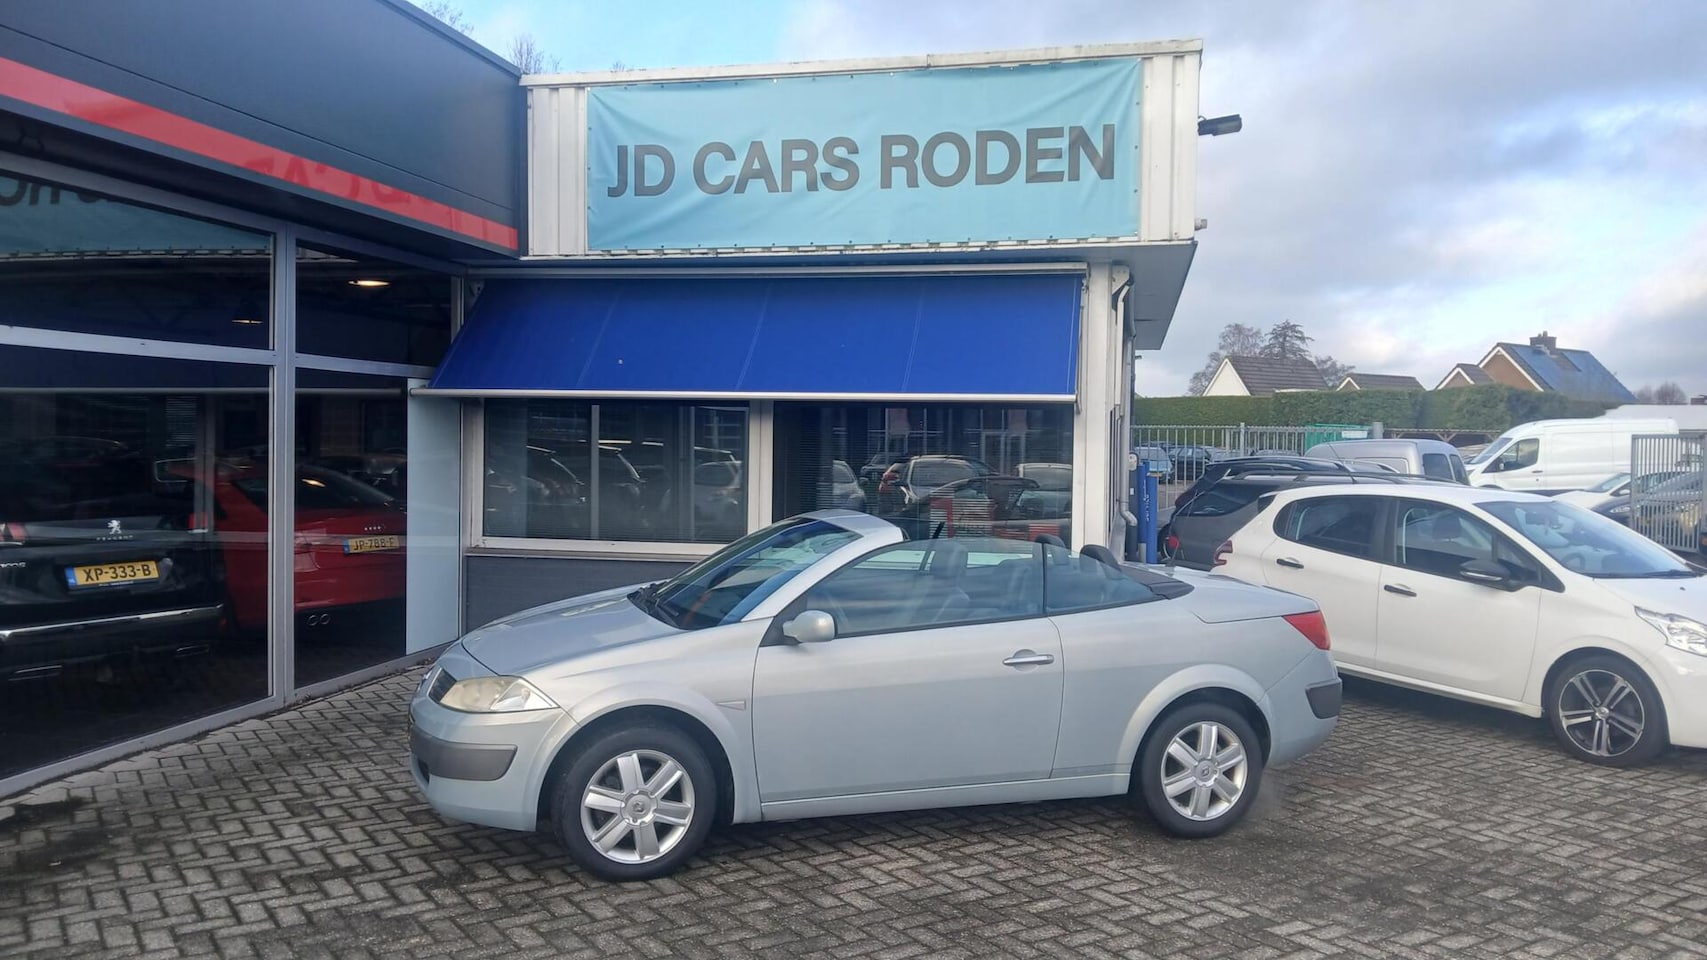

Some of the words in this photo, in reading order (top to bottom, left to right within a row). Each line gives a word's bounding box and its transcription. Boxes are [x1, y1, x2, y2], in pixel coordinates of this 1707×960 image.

[607, 144, 675, 198] JD
[692, 136, 859, 195] CARS
[880, 123, 1115, 190] RODEN
[83, 563, 151, 582] XP-333-B
